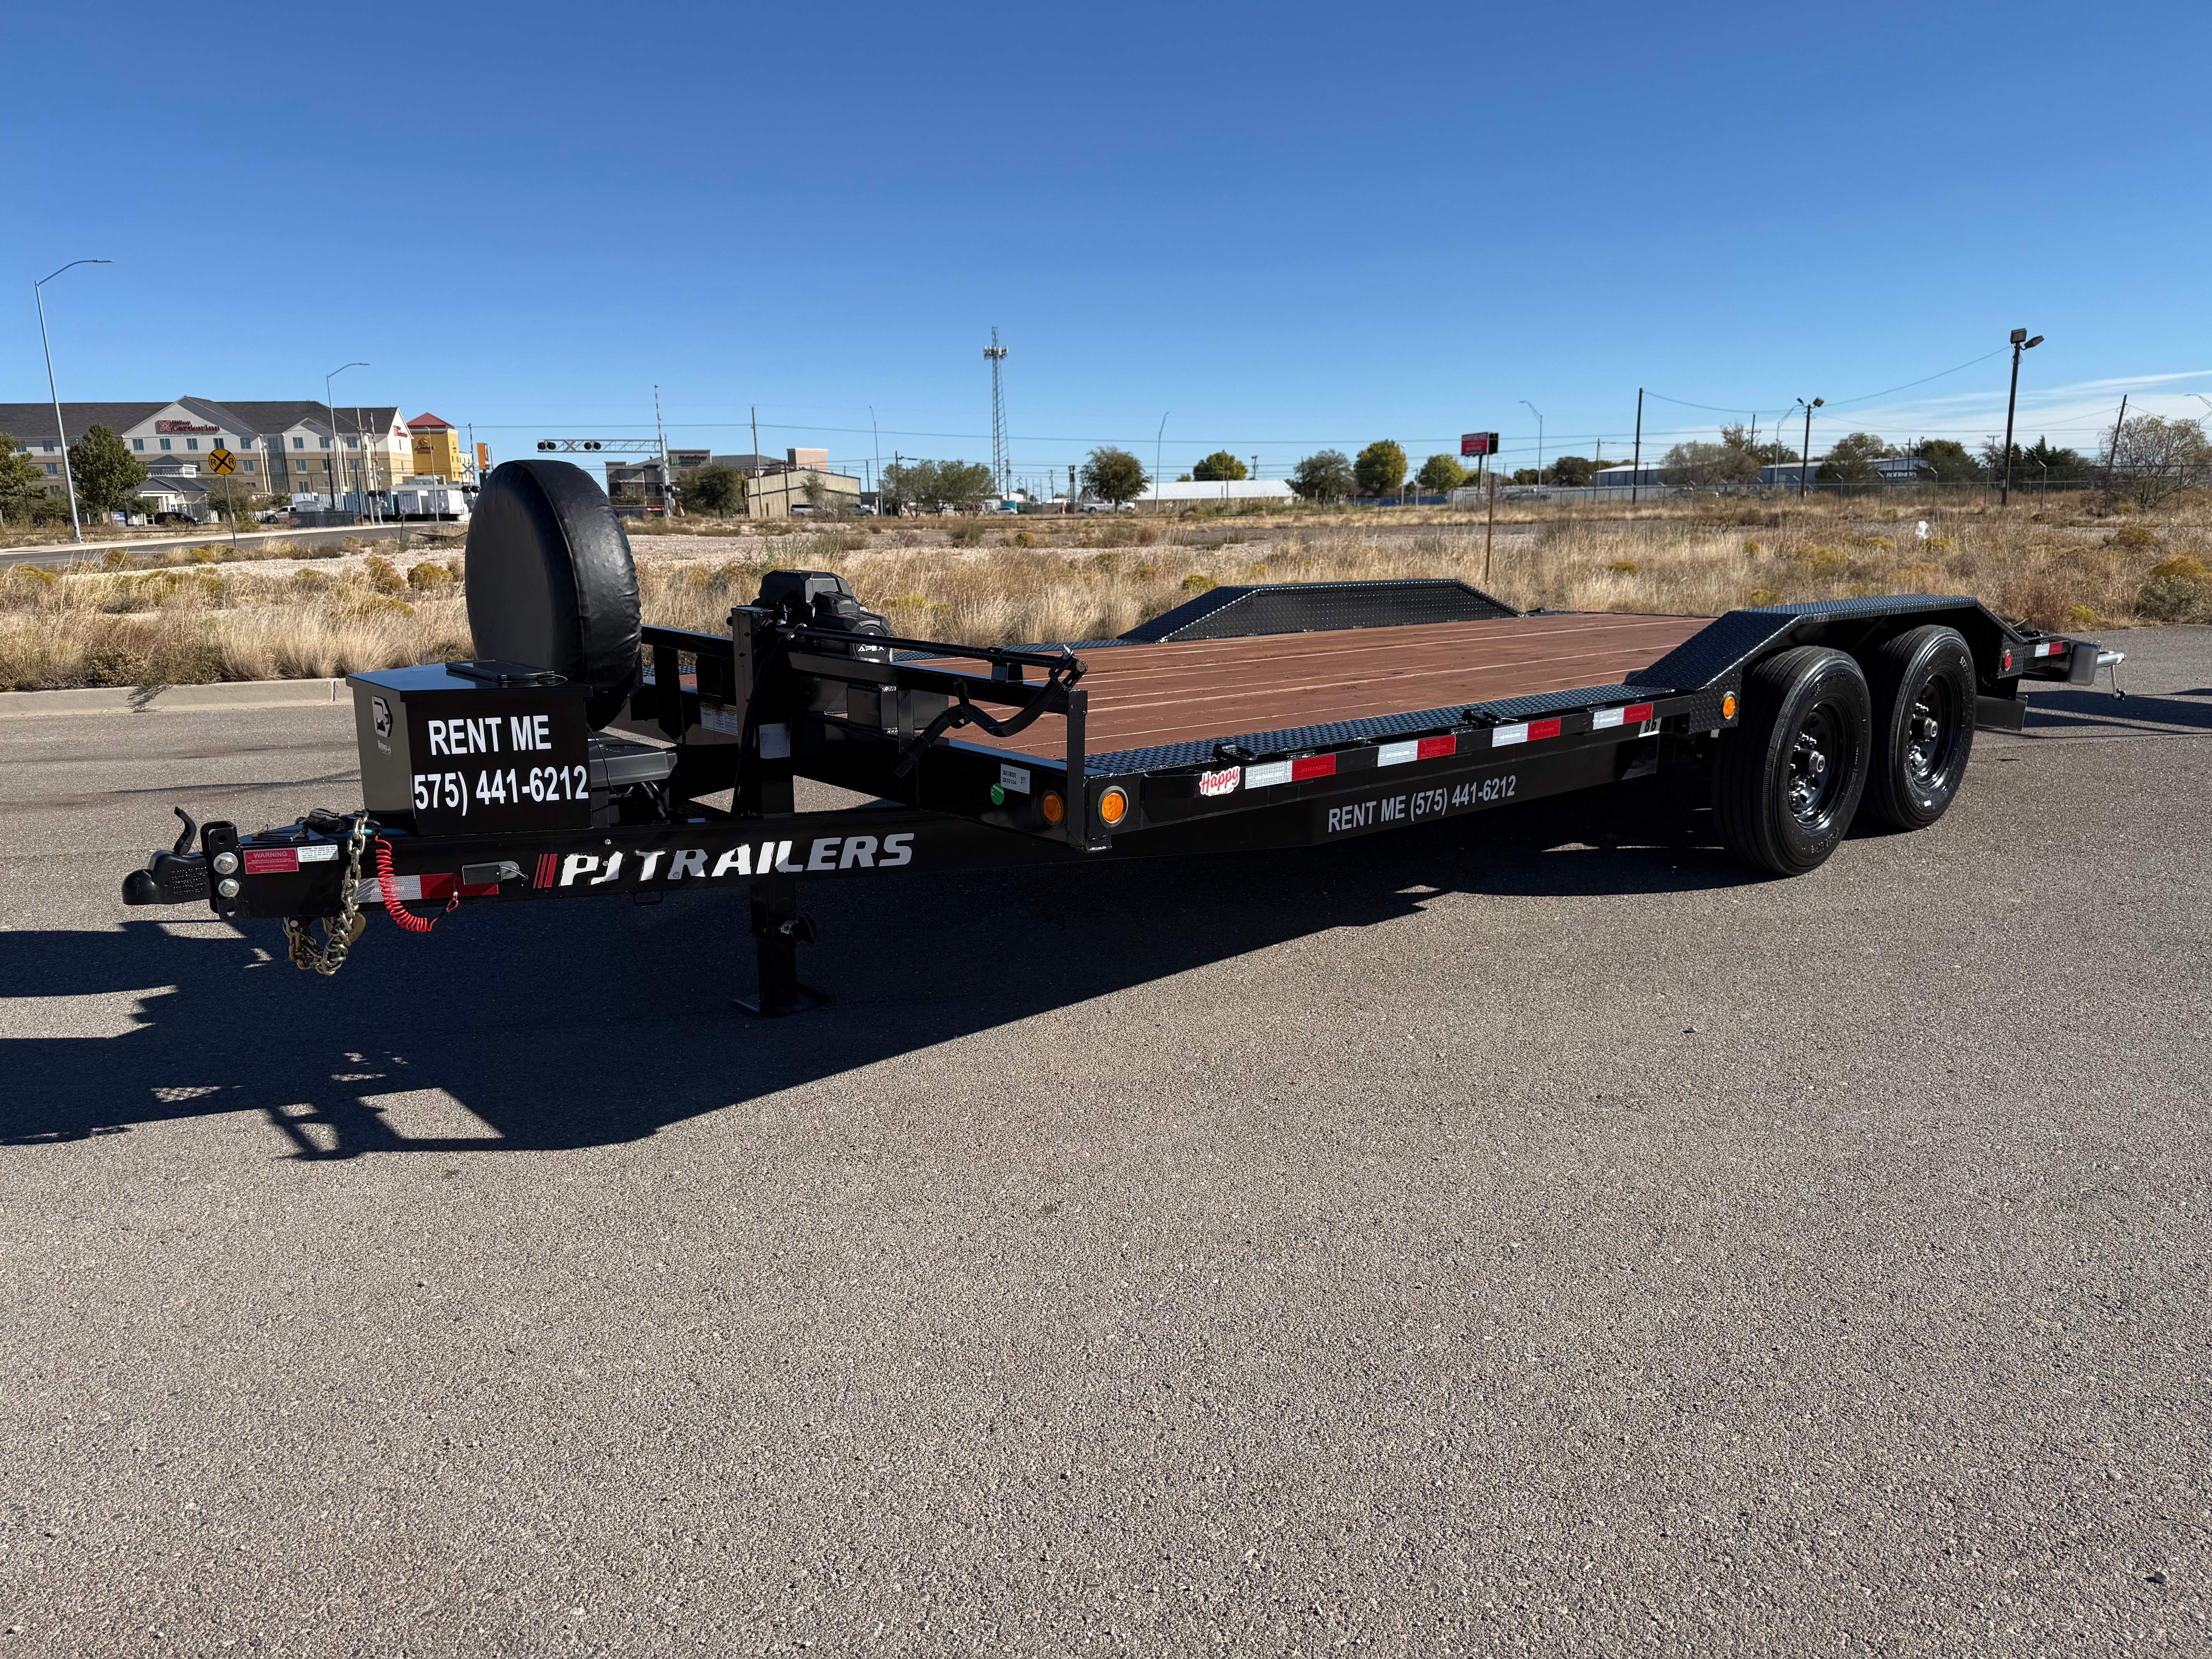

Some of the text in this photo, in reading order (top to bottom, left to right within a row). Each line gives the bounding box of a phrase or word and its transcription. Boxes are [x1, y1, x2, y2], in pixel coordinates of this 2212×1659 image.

[428, 715, 551, 756] RENT ME
[476, 765, 589, 805] 441-6212
[1201, 768, 1239, 793] Happy
[1328, 775, 1516, 833] RENT ME (575) 441-6212
[559, 833, 915, 886] PJ TRAILERS
